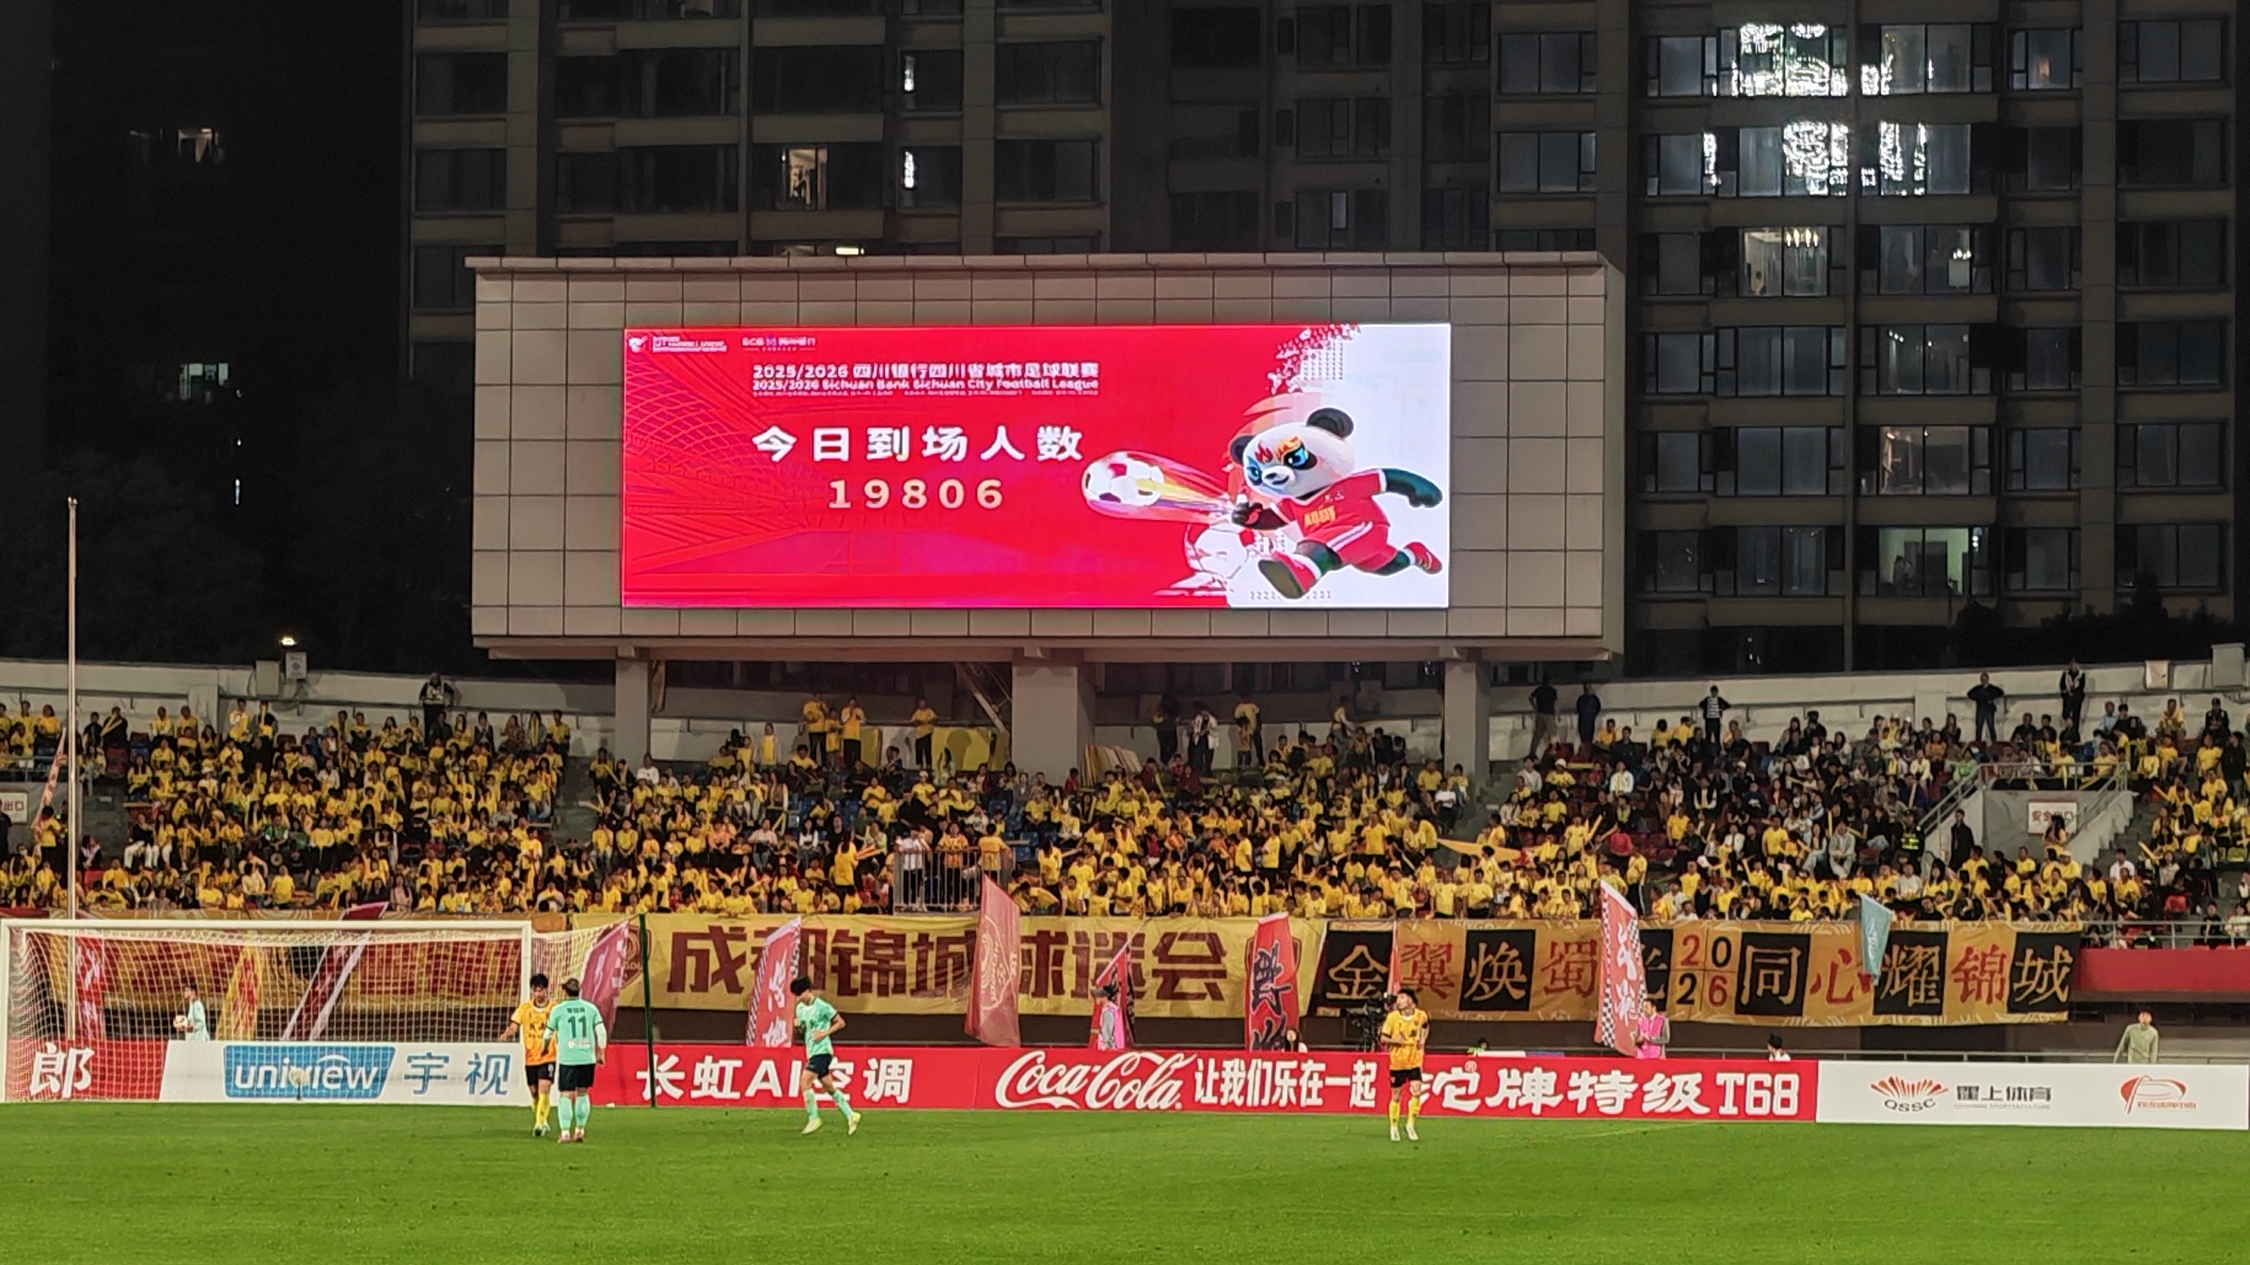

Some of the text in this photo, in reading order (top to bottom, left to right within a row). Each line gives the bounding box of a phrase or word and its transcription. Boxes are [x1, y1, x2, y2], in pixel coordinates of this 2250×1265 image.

[752, 363, 849, 380] 2025/2026
[752, 379, 1099, 391] 2025/2026 Sichuan Bank Sichuan City Football League
[751, 425, 1083, 462] 今日到场人数
[828, 479, 1004, 509] 19806
[1740, 944, 2074, 1006] 同心耀锦城
[567, 1015, 587, 1038] 11
[30, 1041, 95, 1098] 郎
[404, 1052, 512, 1096] 宇视
[995, 1050, 1197, 1110] Coca-Cola
[1194, 1057, 1377, 1108] 让我们乐在一起
[1884, 1098, 1936, 1112] QSSC
